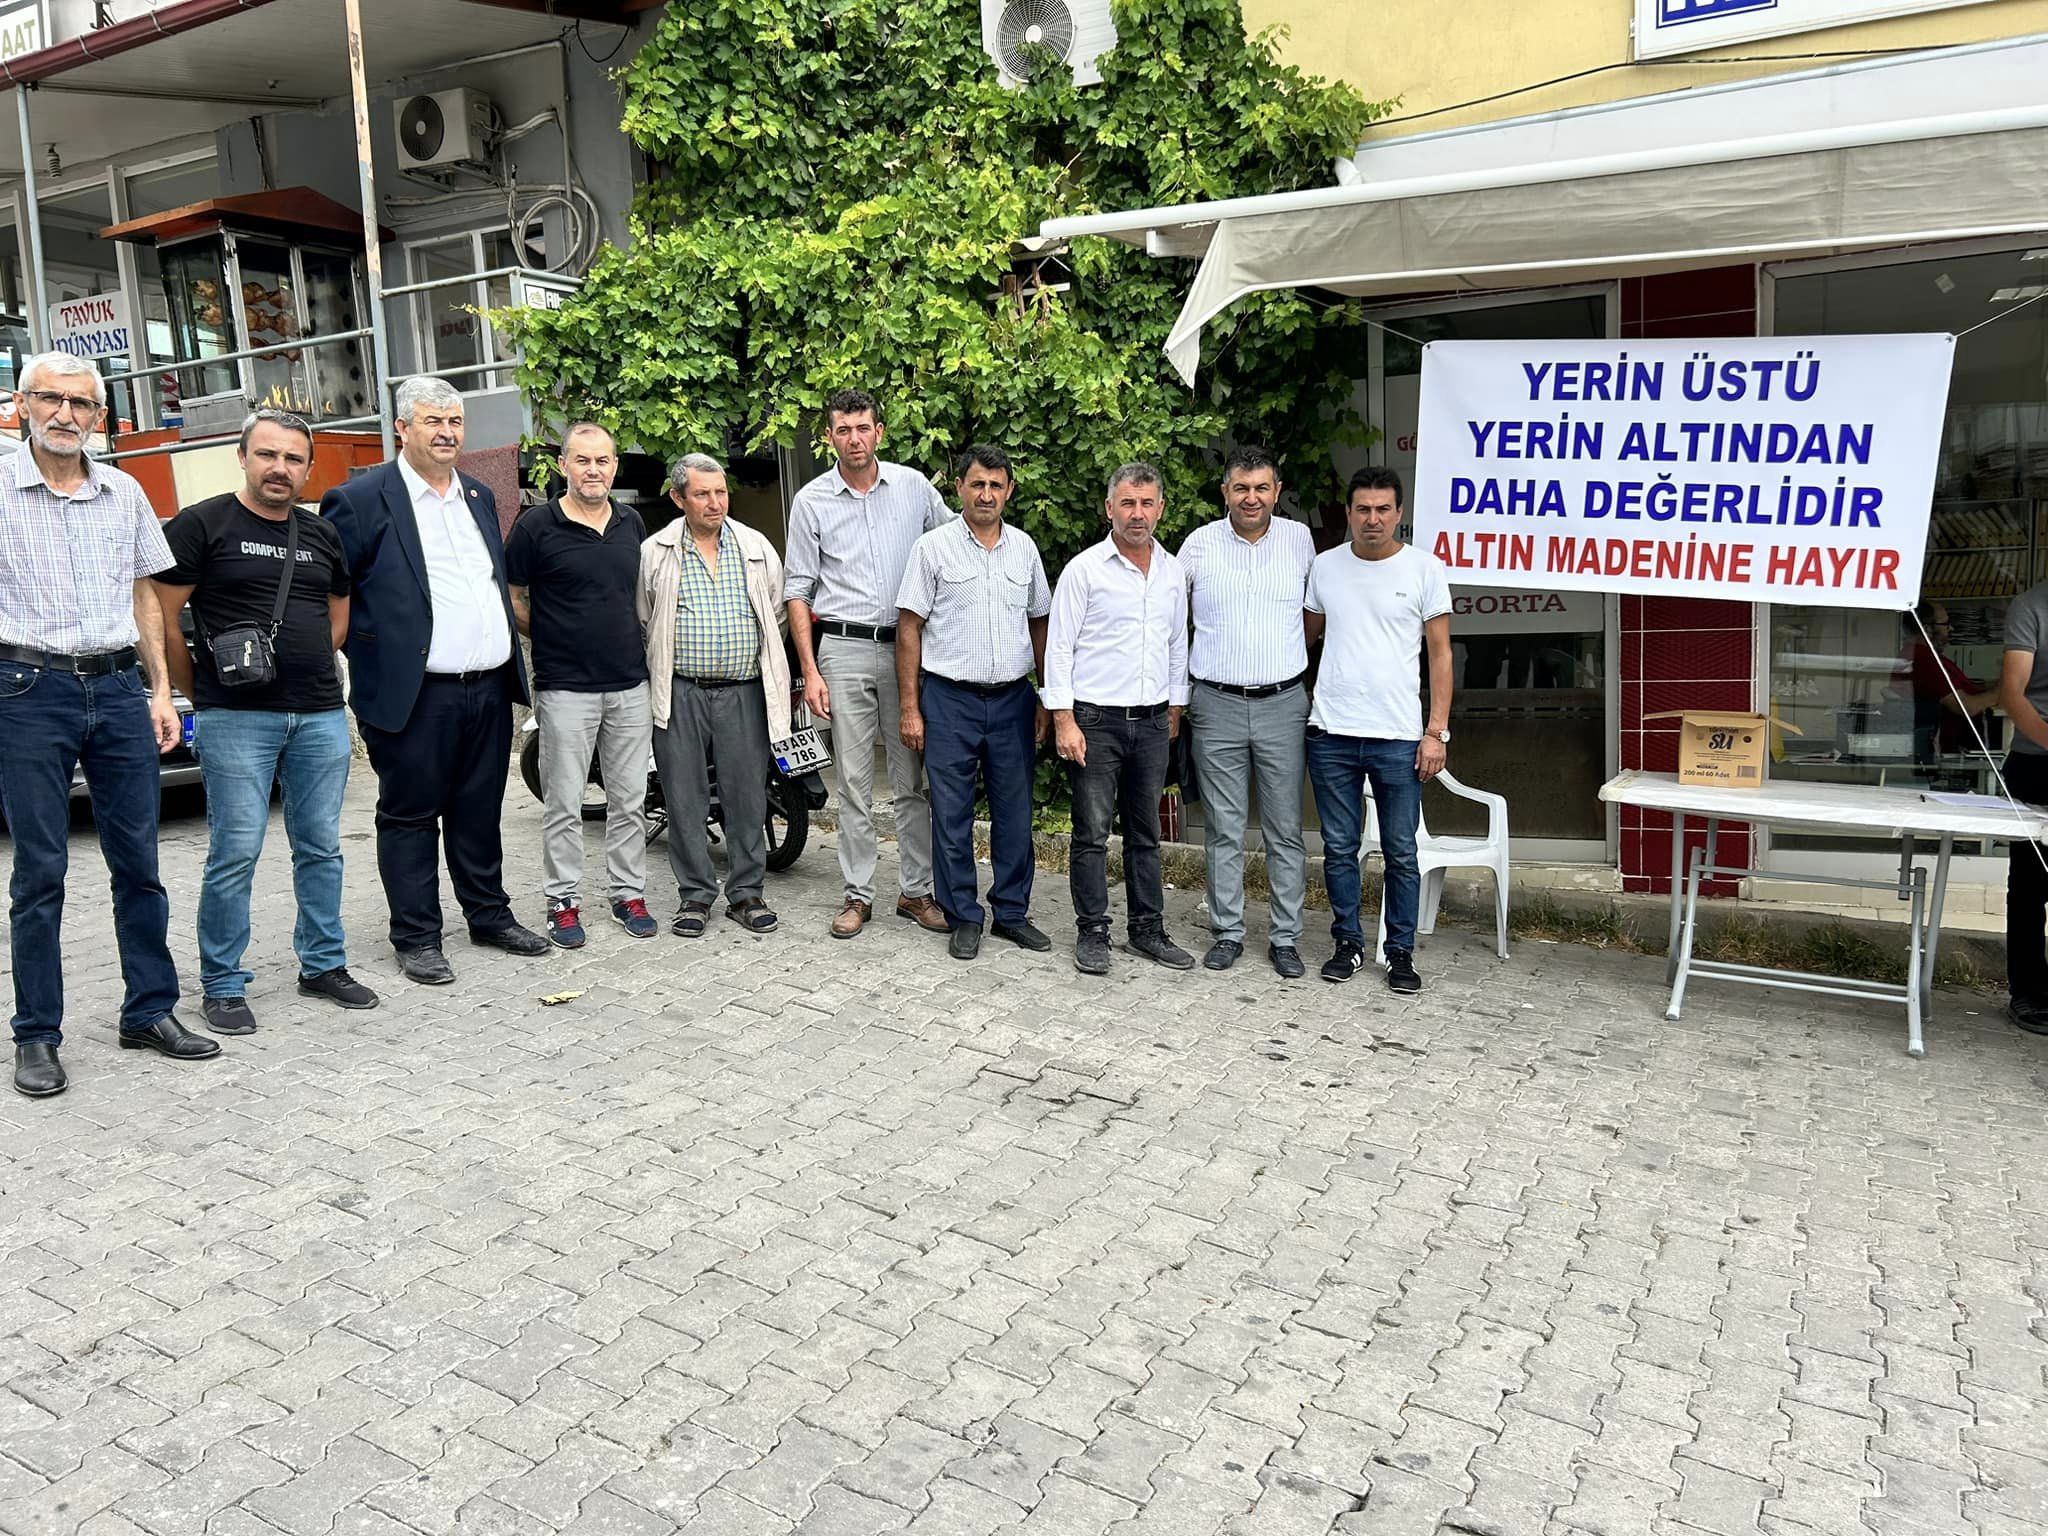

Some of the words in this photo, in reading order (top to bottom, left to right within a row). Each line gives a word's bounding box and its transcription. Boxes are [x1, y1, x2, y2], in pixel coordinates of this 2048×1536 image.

[60, 299, 114, 328] TAVUK
[56, 328, 129, 357] DÜNYASI
[1522, 351, 1664, 402] YERİN
[1682, 350, 1820, 402] ÜSTÜ
[1468, 411, 1604, 461] YERİN
[1618, 422, 1873, 465] ALTINDAN
[1450, 477, 1567, 517] DAHA
[1583, 472, 1883, 528] DEĞERLİDİR
[240, 541, 313, 562] COMPLEENT
[1433, 531, 1534, 571] ALTIN
[1546, 531, 1754, 583] MADENİNE
[1767, 545, 1900, 590] HAYIR
[790, 731, 816, 749] ABV
[791, 747, 817, 764] 786
